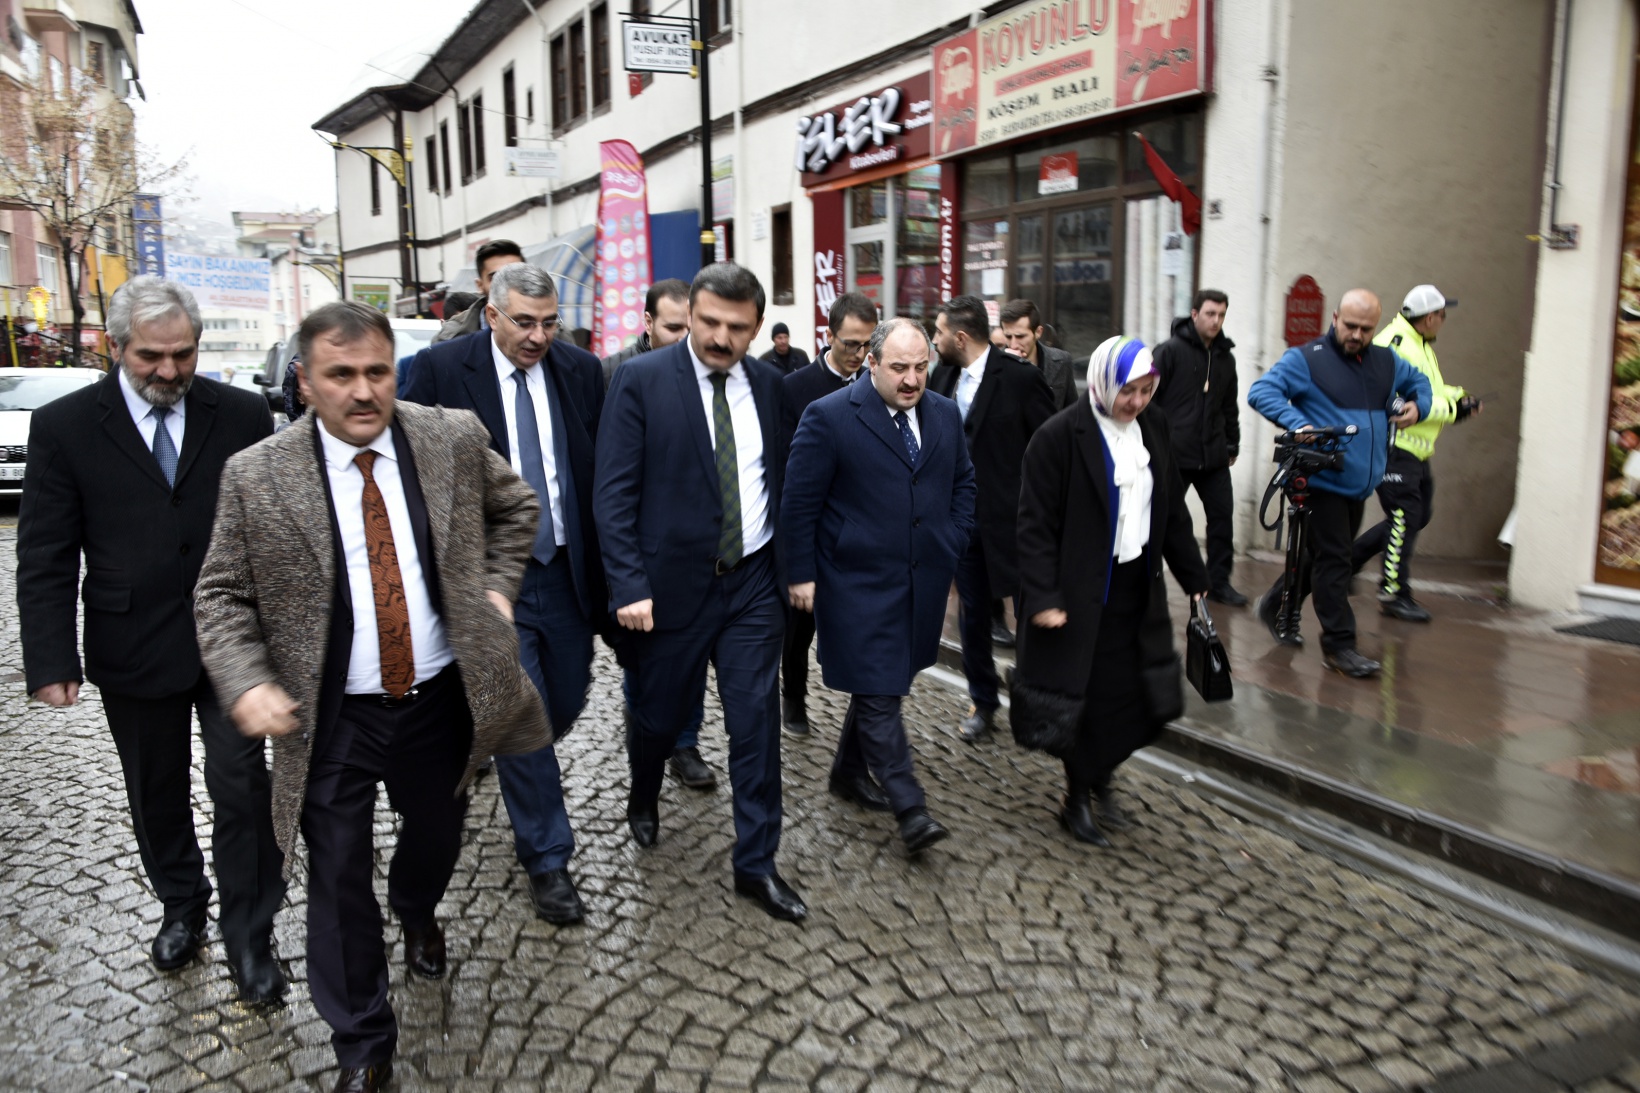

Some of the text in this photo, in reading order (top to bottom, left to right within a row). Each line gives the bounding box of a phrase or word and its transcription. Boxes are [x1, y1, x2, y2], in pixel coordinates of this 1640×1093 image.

[632, 30, 689, 45] AVUKAT
[982, 0, 1110, 75] KOYUNLU
[1052, 76, 1099, 100] HALI
[168, 254, 270, 275] SAYIN BAKANIMIZ
